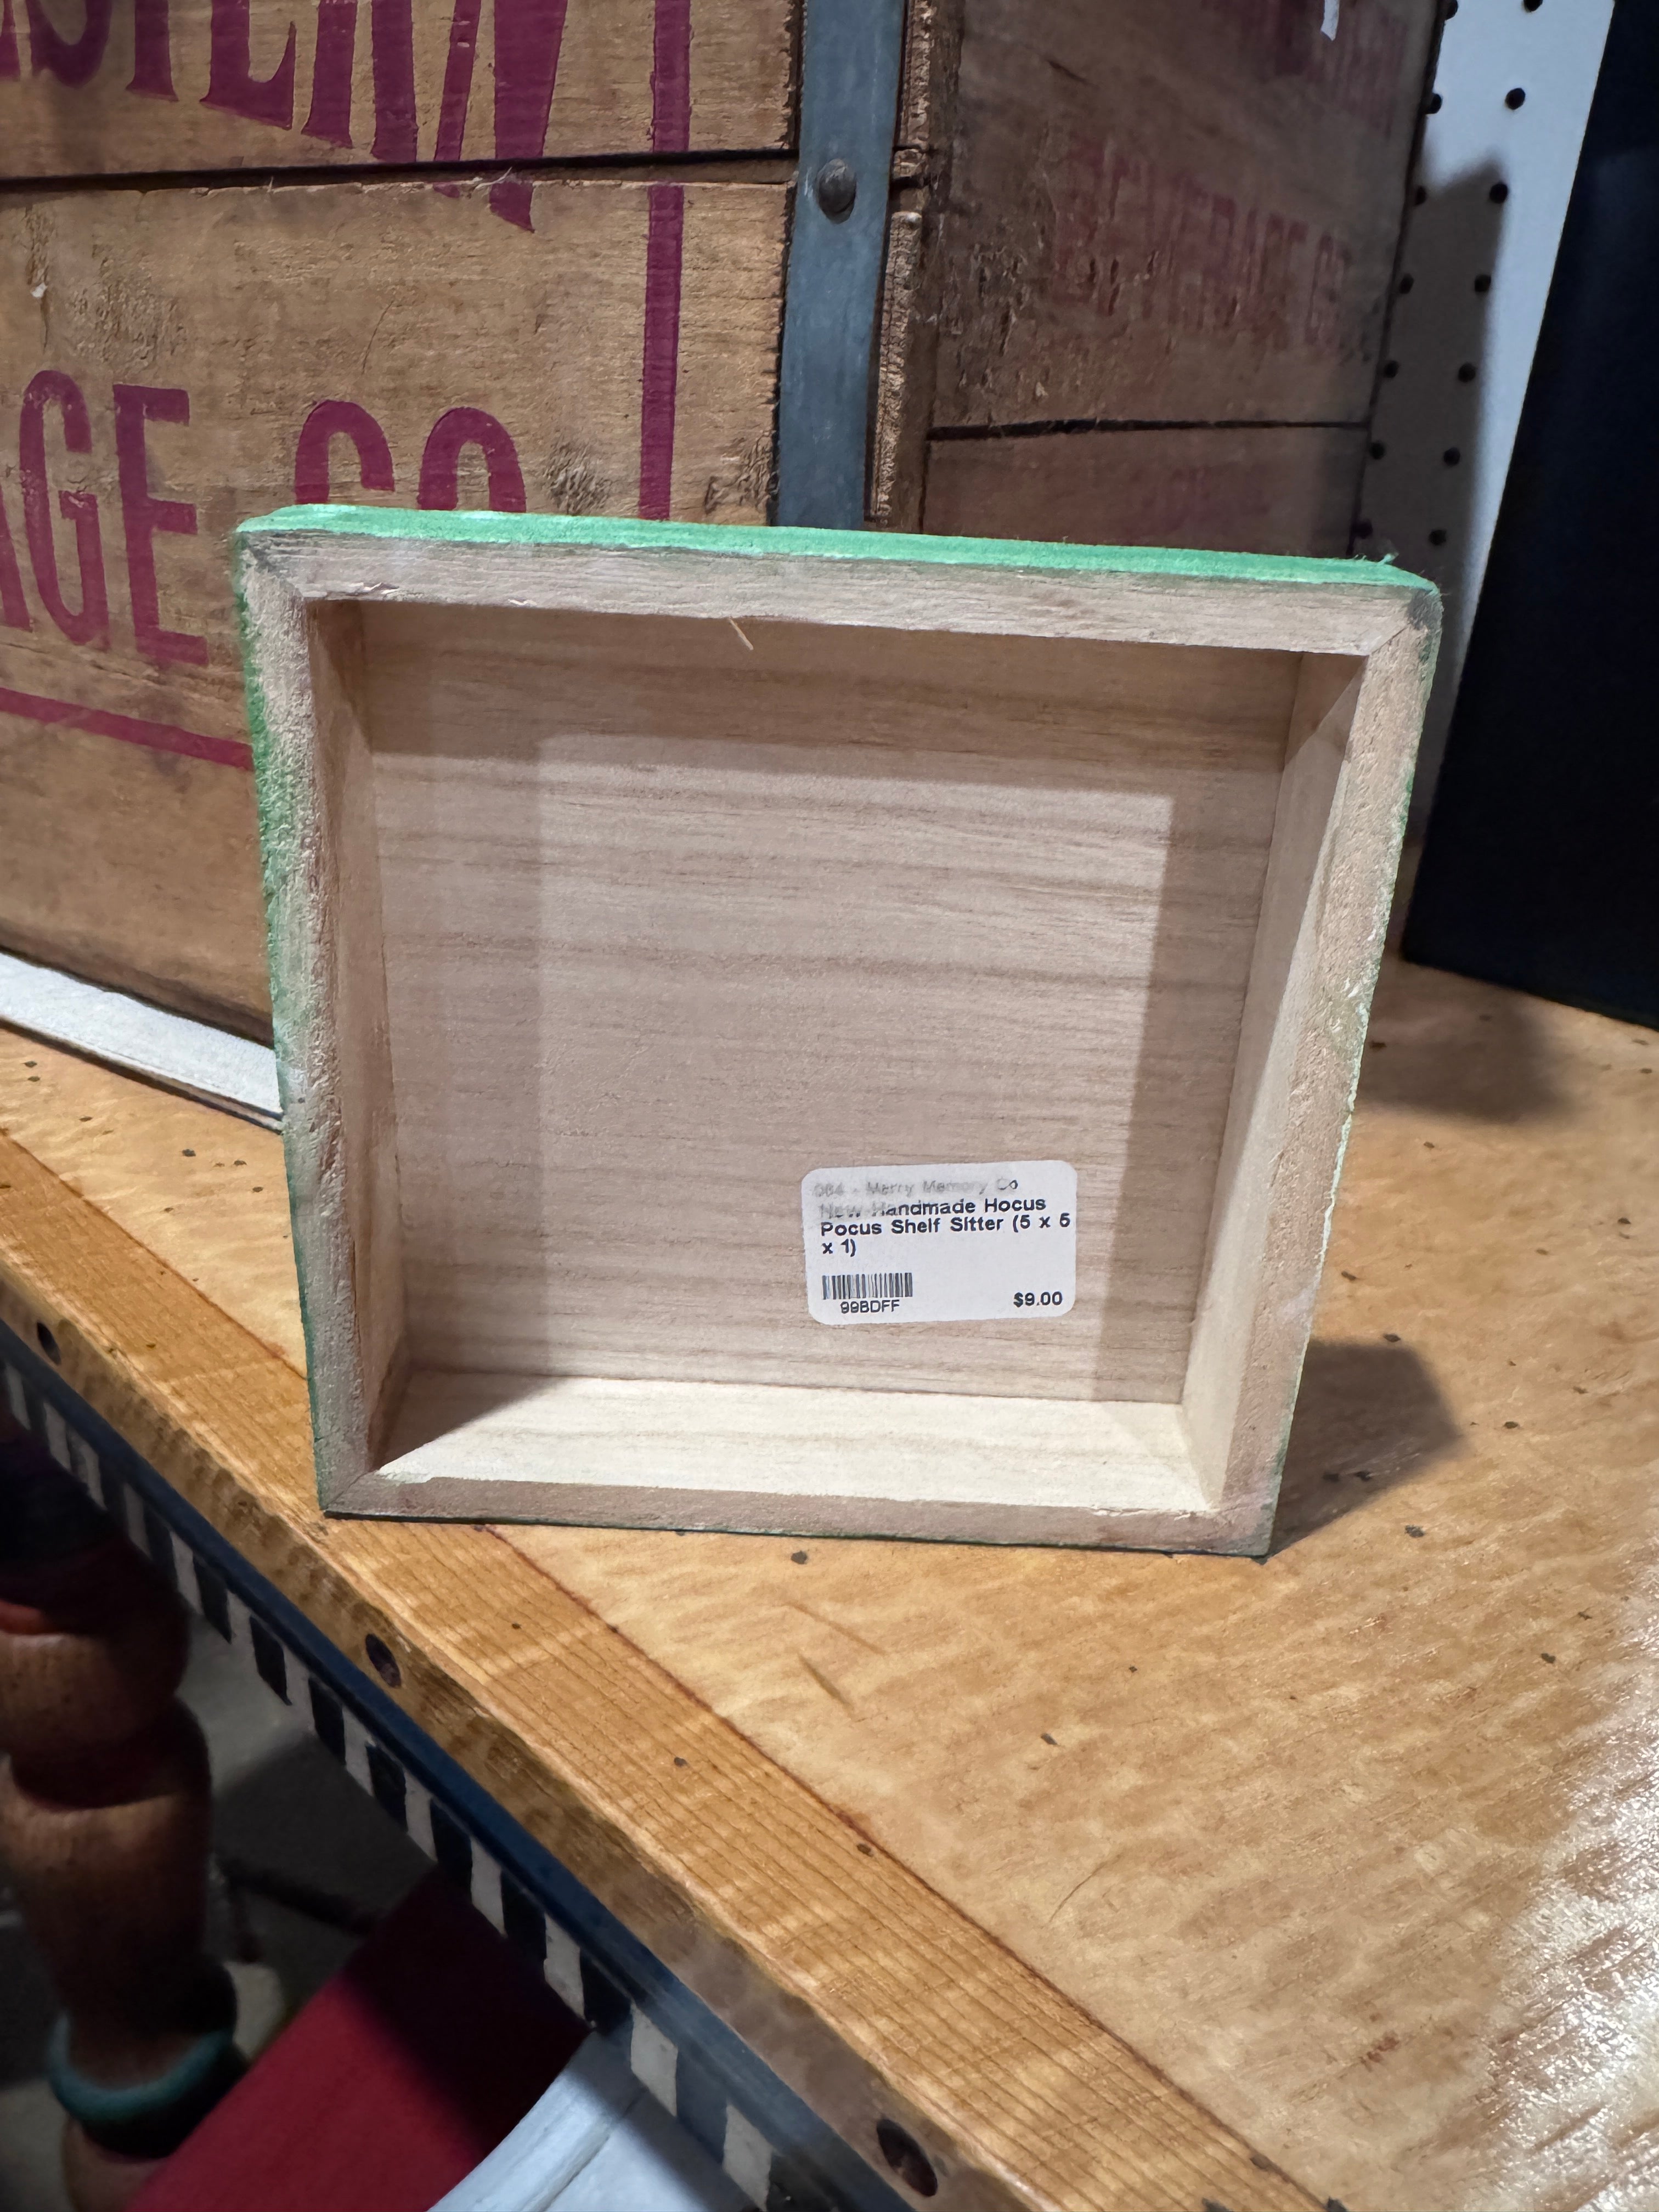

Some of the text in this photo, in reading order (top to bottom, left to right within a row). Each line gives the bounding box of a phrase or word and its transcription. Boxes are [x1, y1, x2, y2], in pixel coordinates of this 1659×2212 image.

[0, 370, 208, 666] GE
[871, 1198, 976, 1217] Handmade
[985, 1198, 1046, 1213] Hocus
[821, 1222, 882, 1236] Pocus
[891, 1217, 940, 1234] Shelf
[950, 1216, 1003, 1232] Sitter
[1039, 1216, 1051, 1228] x
[822, 1238, 856, 1257] x 1)
[1013, 1291, 1063, 1308] $9.00
